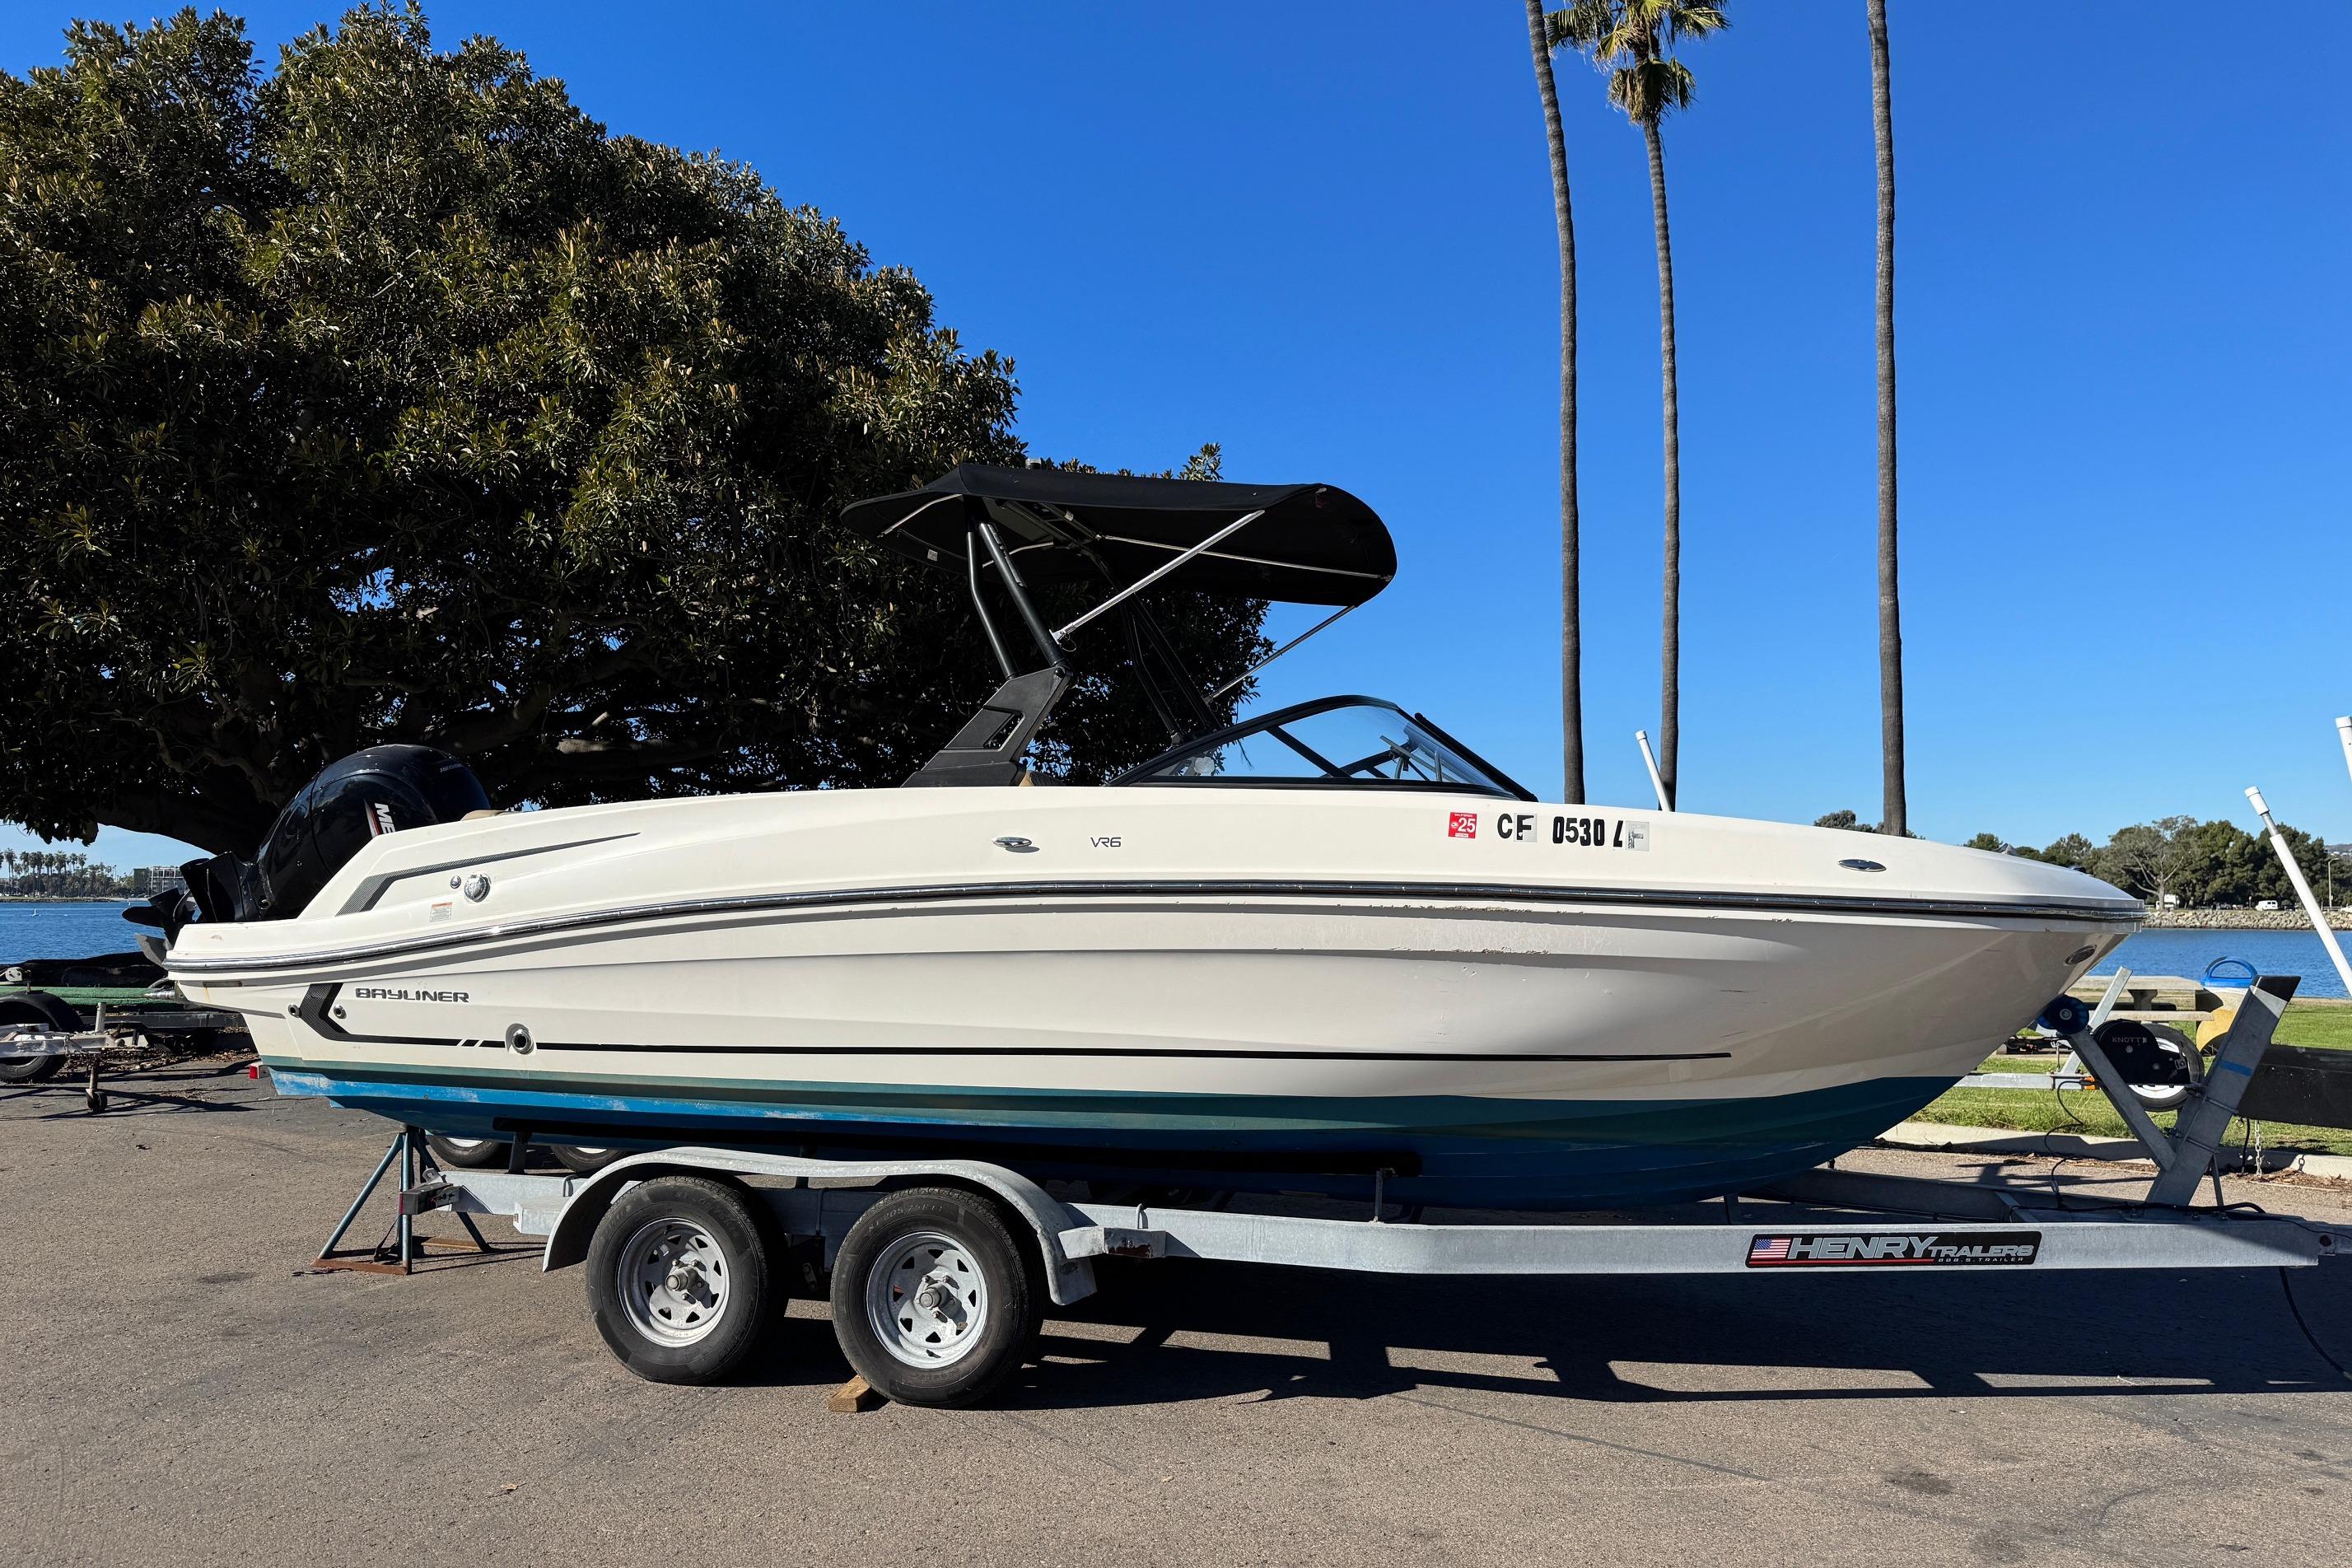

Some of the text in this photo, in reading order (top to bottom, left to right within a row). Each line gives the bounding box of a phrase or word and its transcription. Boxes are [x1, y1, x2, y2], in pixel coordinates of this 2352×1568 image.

[1458, 817, 1476, 833] 25
[1497, 813, 1534, 840] CF
[1552, 816, 1605, 846] 0530
[1090, 837, 1122, 847] VR6
[355, 987, 469, 1003] BAYLINER
[1787, 1236, 2034, 1259] HENRY TRAILERS
